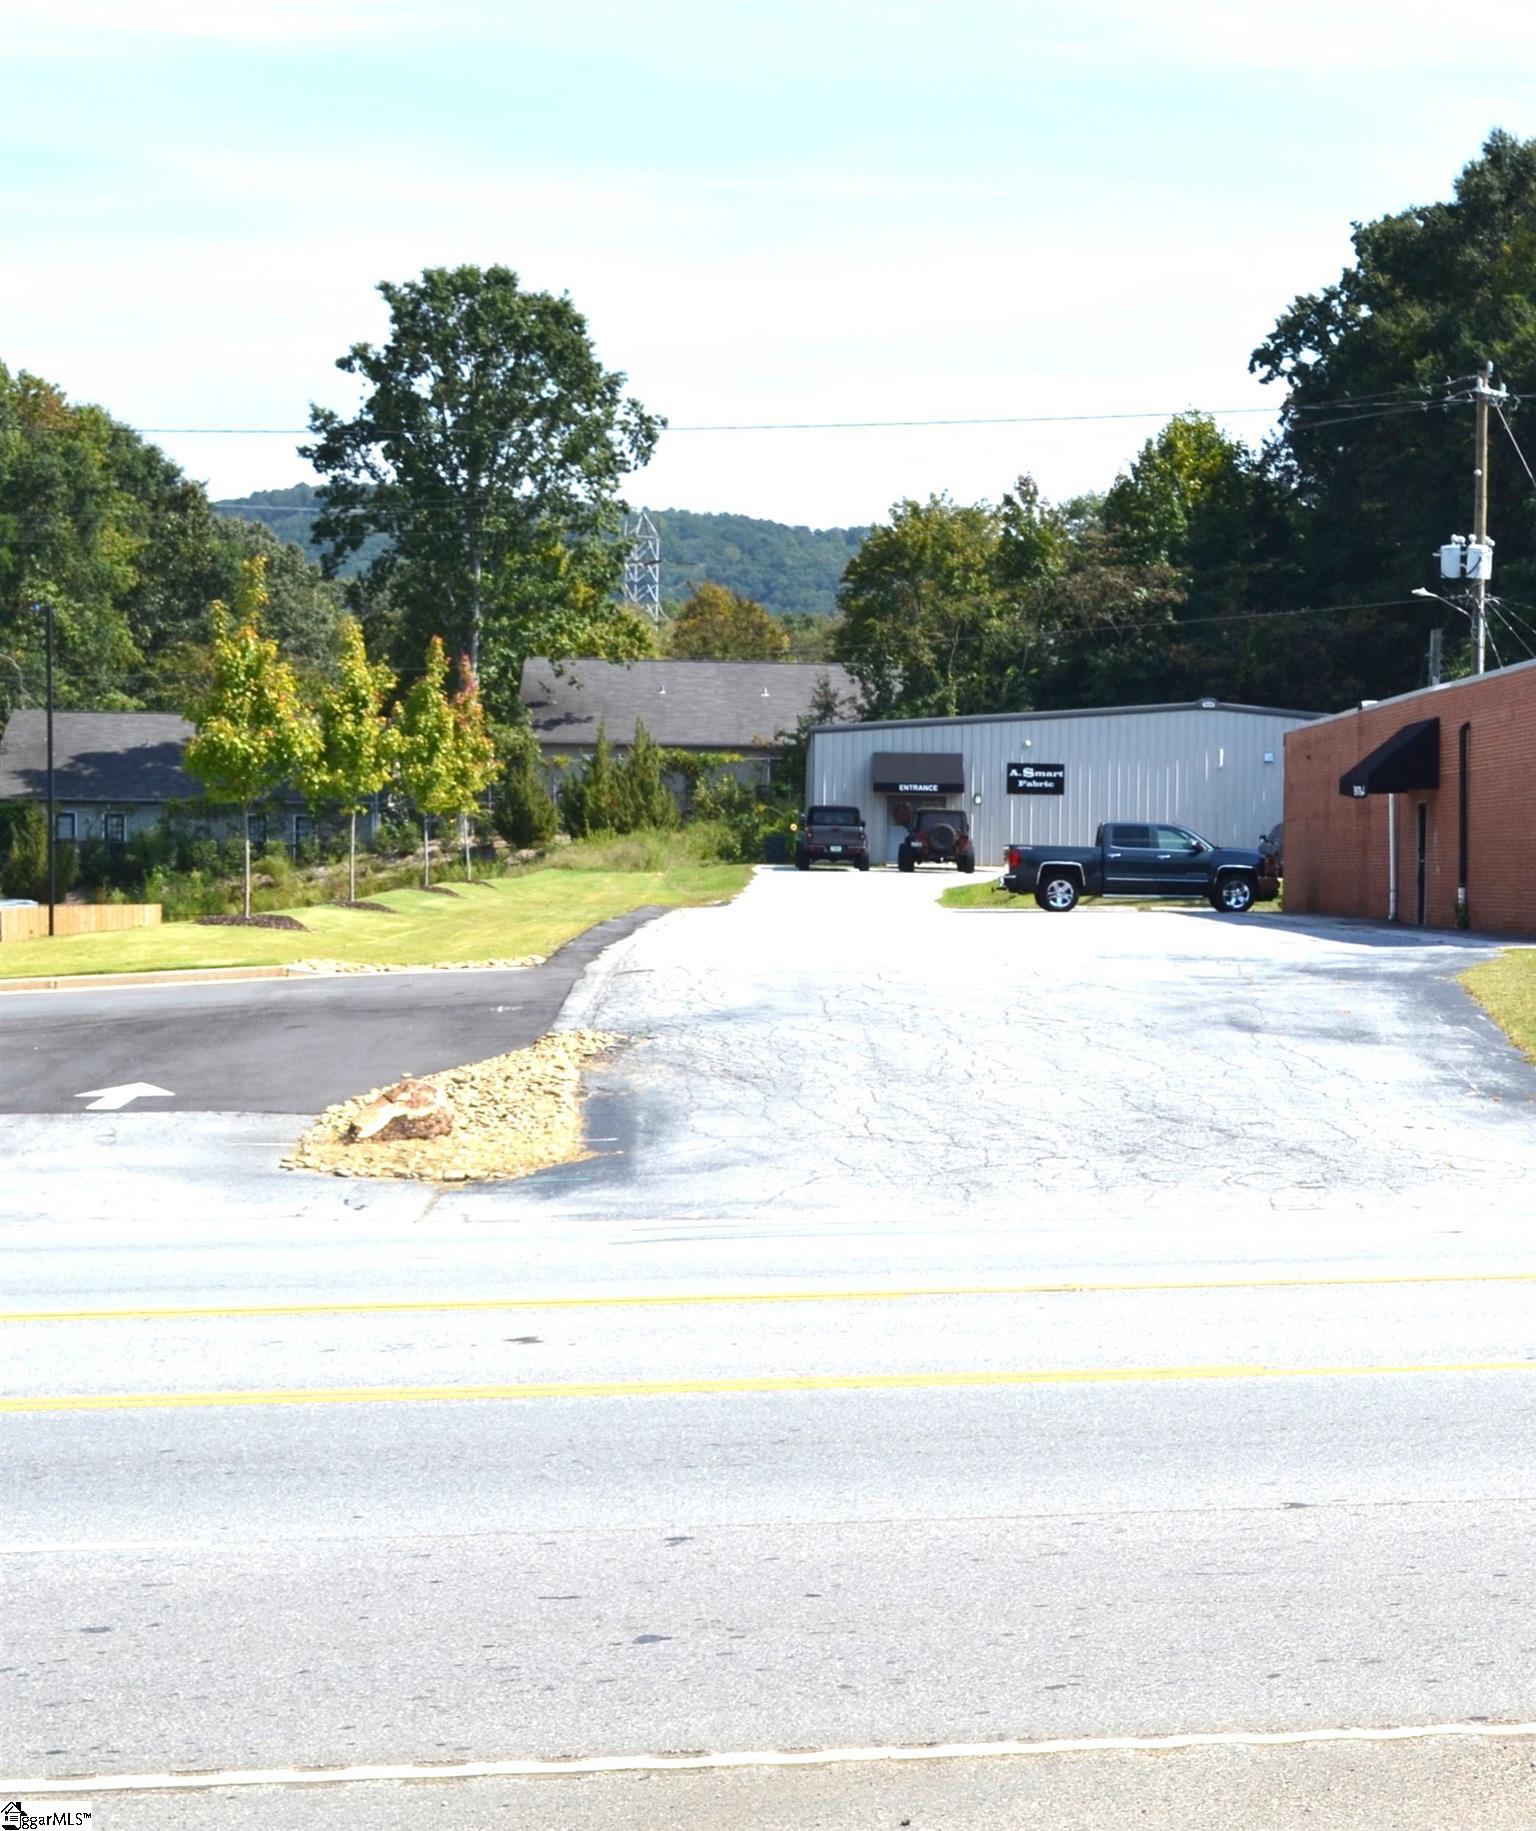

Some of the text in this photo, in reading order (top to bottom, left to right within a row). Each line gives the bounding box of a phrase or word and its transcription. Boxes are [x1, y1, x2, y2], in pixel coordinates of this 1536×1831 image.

[1009, 767, 1063, 778] A. Smart
[899, 784, 939, 792] ENTRANCE
[1018, 780, 1054, 788] Fabric
